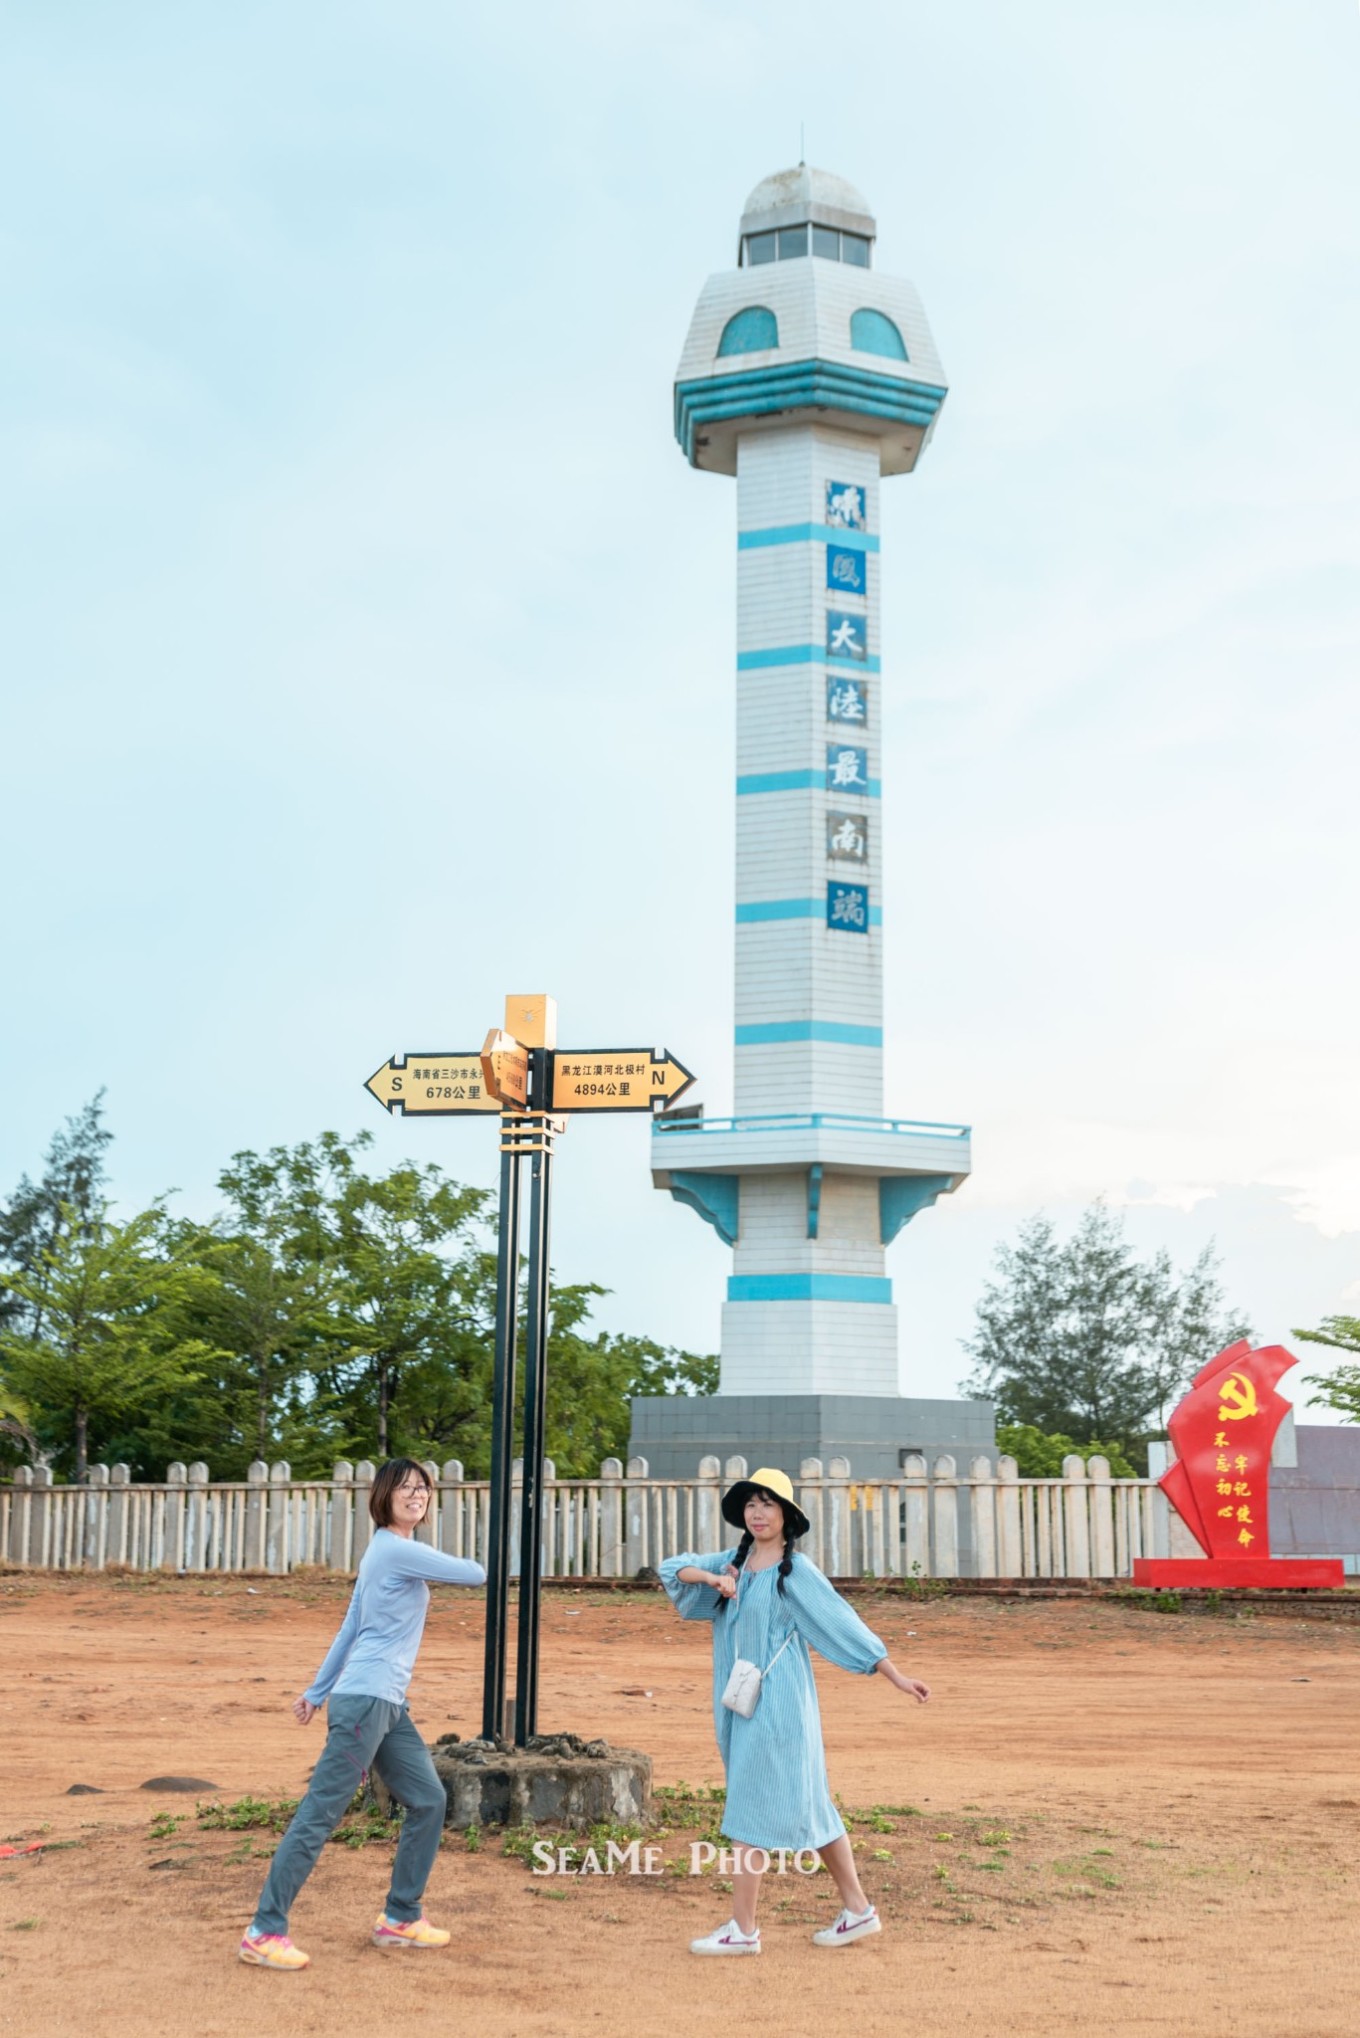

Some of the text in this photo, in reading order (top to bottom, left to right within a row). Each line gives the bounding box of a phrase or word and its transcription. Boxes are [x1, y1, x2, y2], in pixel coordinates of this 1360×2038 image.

[561, 1064, 645, 1076] 黑龙江漠河北极村
[391, 1077, 403, 1091] S
[651, 1070, 665, 1085] N
[426, 1085, 481, 1099] 678公里
[574, 1082, 631, 1096] 4894公里
[1214, 1431, 1233, 1518] 不忘初心
[1233, 1454, 1255, 1548] 牢记使命
